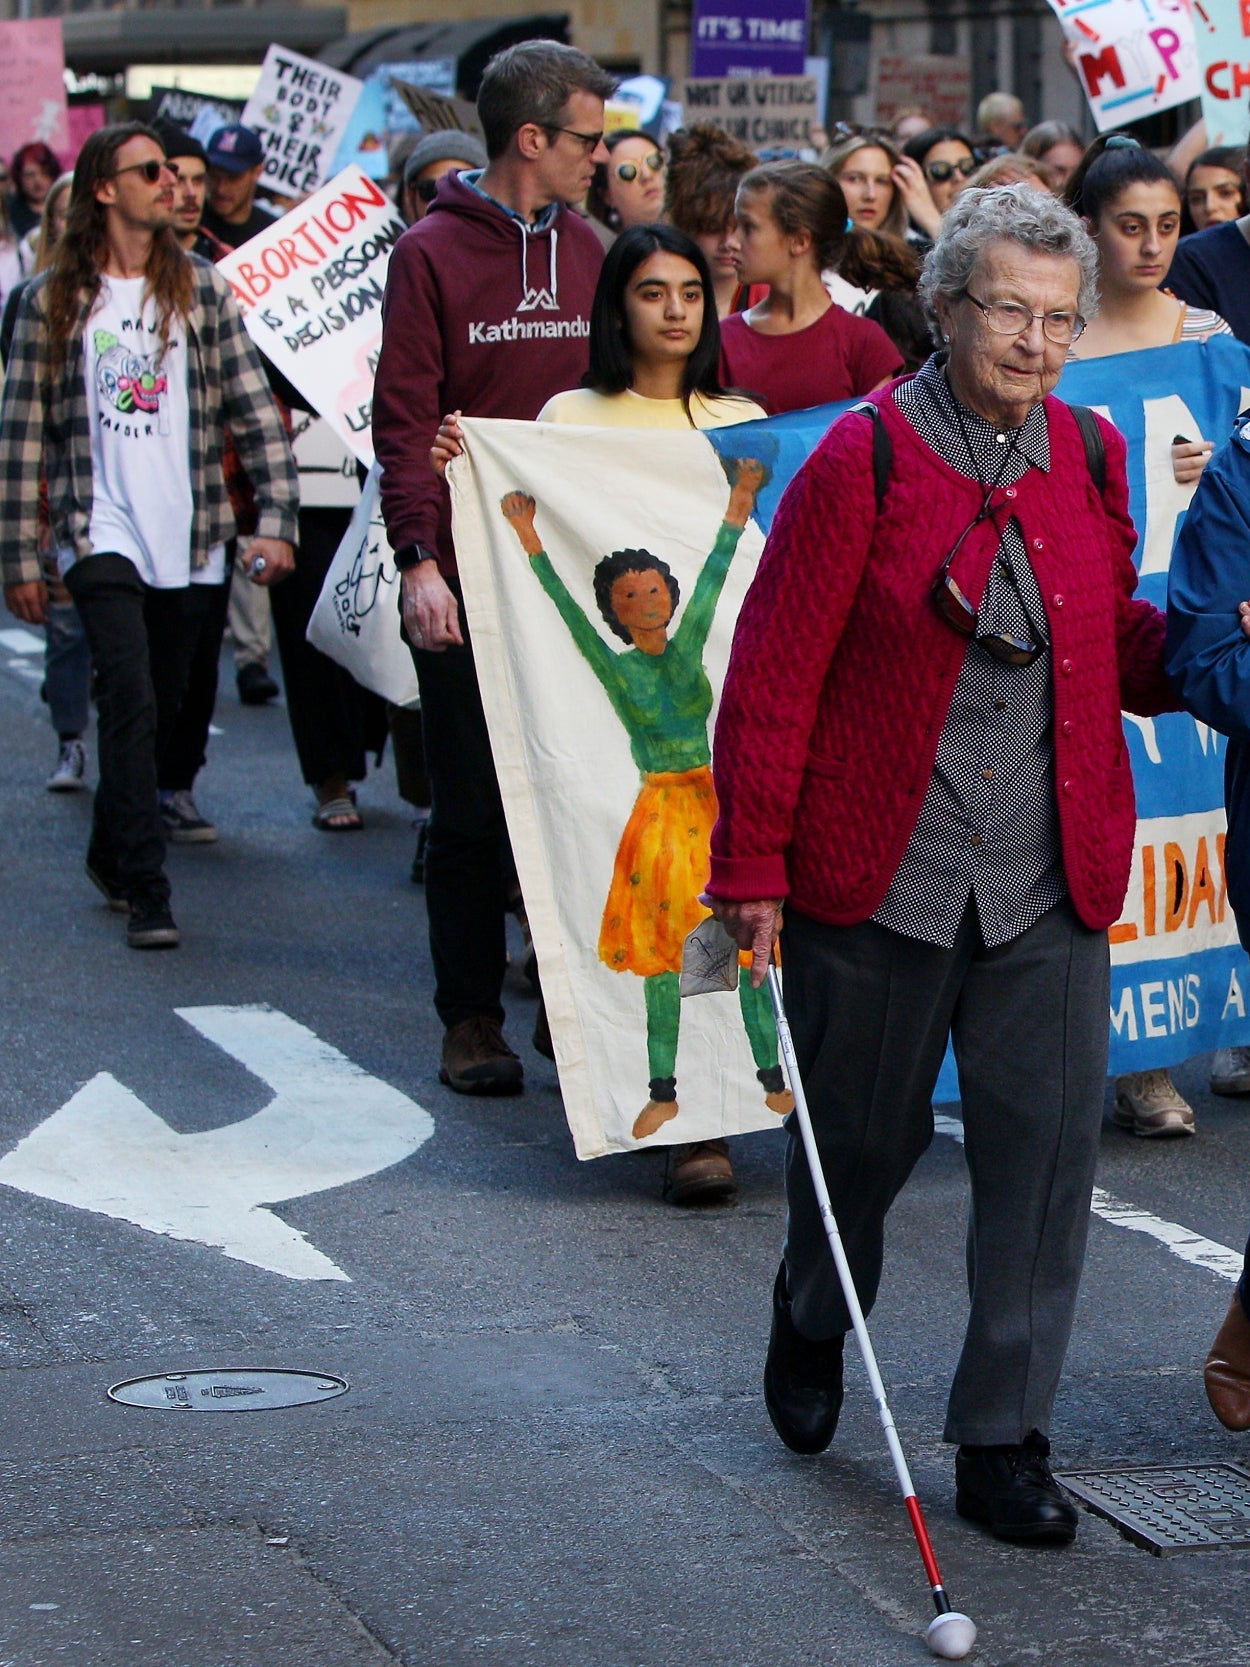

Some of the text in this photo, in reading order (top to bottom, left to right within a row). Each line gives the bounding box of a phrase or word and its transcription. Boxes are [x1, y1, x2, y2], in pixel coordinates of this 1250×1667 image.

[746, 17, 805, 42] TIME
[275, 57, 342, 101] THEIR
[277, 85, 332, 116] BODY
[226, 176, 386, 308] ABORTION
[259, 308, 284, 333] IS
[287, 295, 309, 317] A
[283, 277, 384, 354] DECISION
[468, 314, 590, 344] Kathmandu
